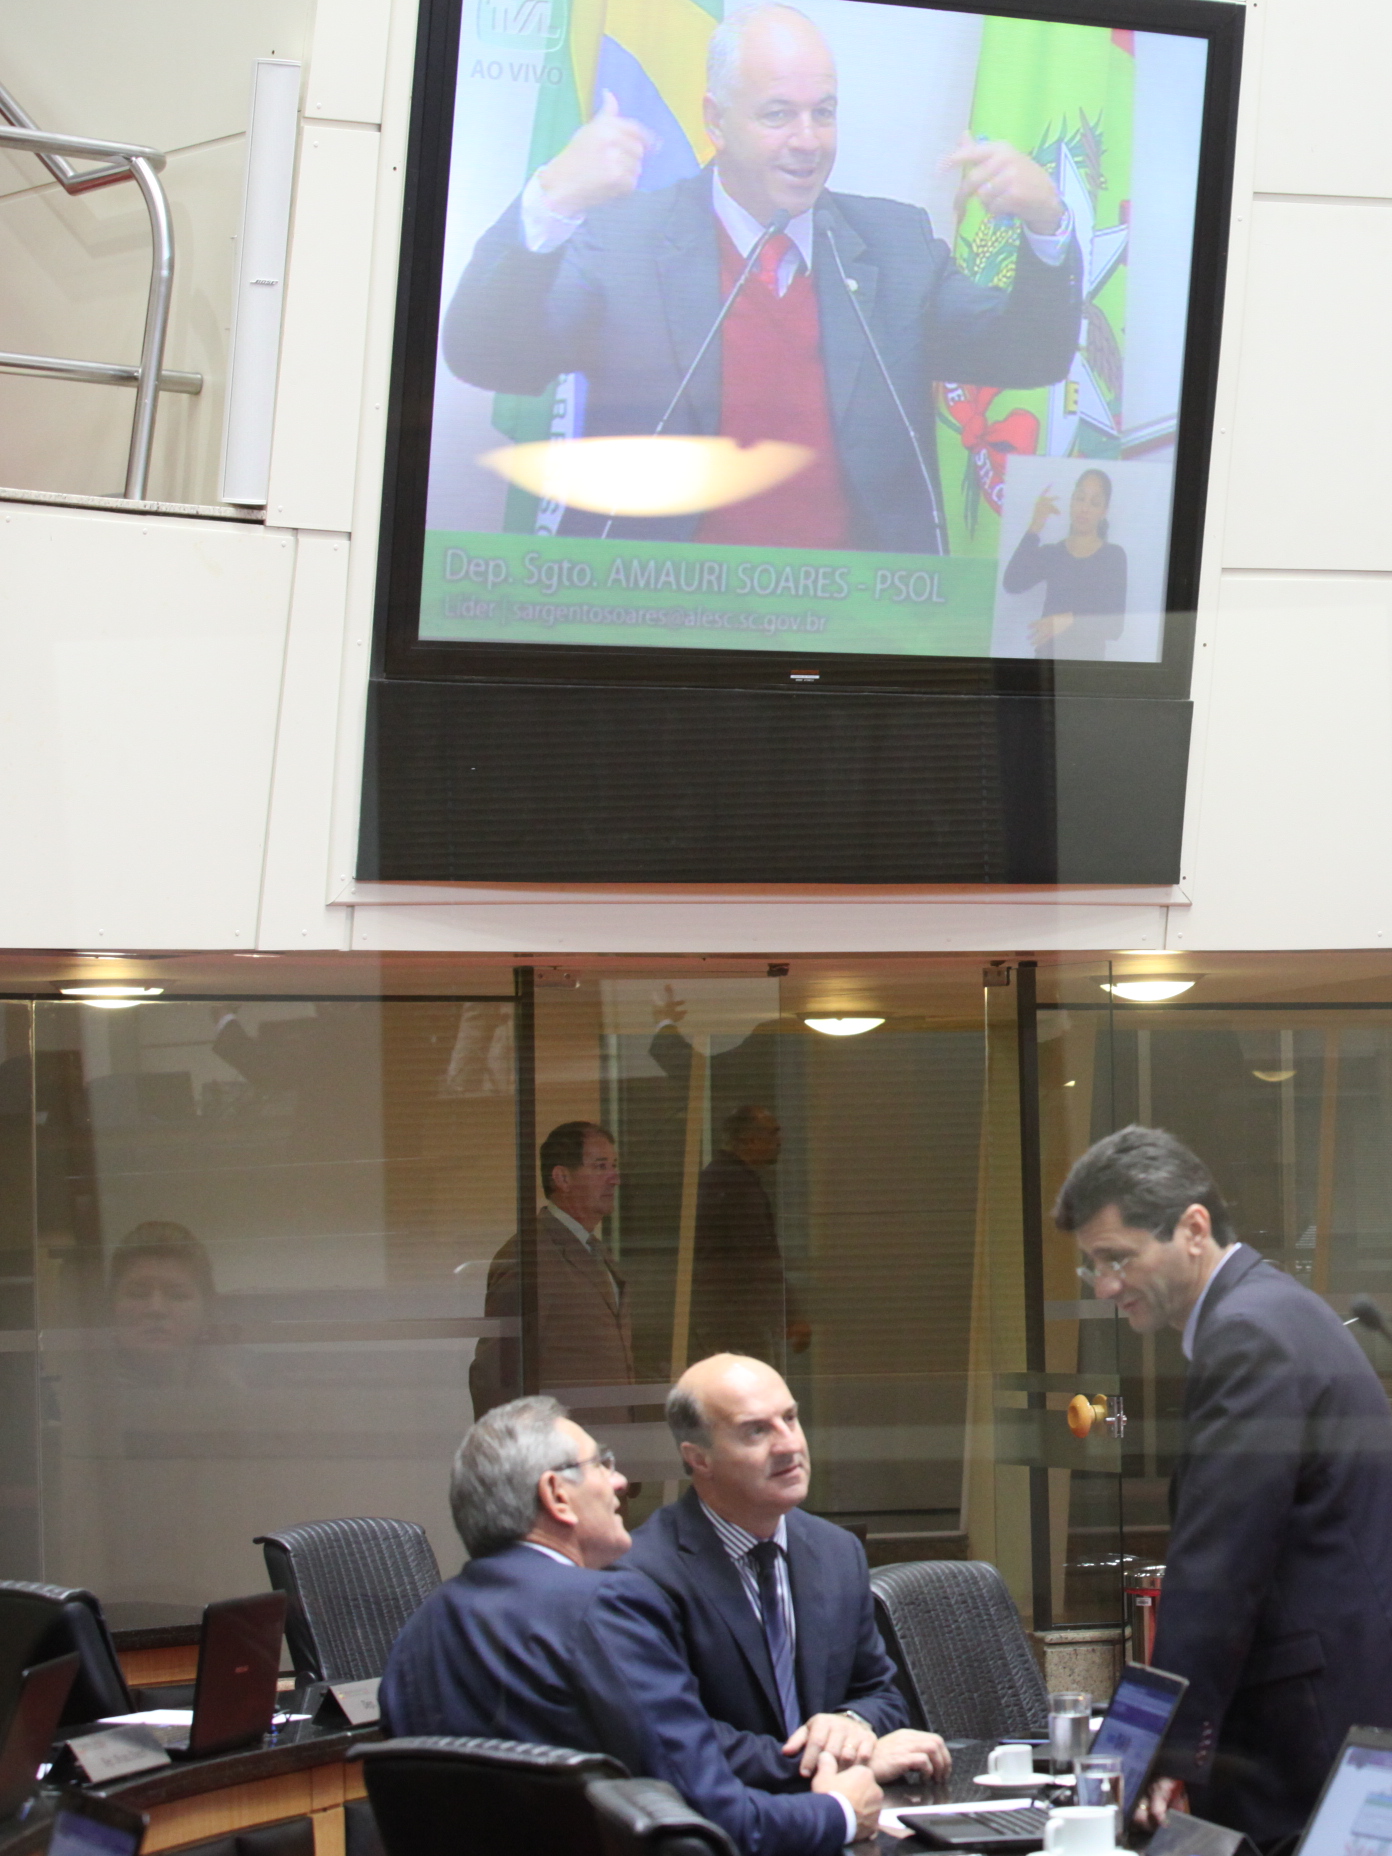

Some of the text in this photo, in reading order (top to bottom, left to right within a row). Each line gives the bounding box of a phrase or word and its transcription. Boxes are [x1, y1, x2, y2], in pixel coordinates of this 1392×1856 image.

[470, 59, 563, 85] AO VIVO
[445, 549, 513, 590] Dep.
[525, 552, 598, 594] Sgto.
[607, 557, 728, 592] AMAURI
[736, 563, 849, 598] SOARES
[875, 569, 946, 603] PSOL
